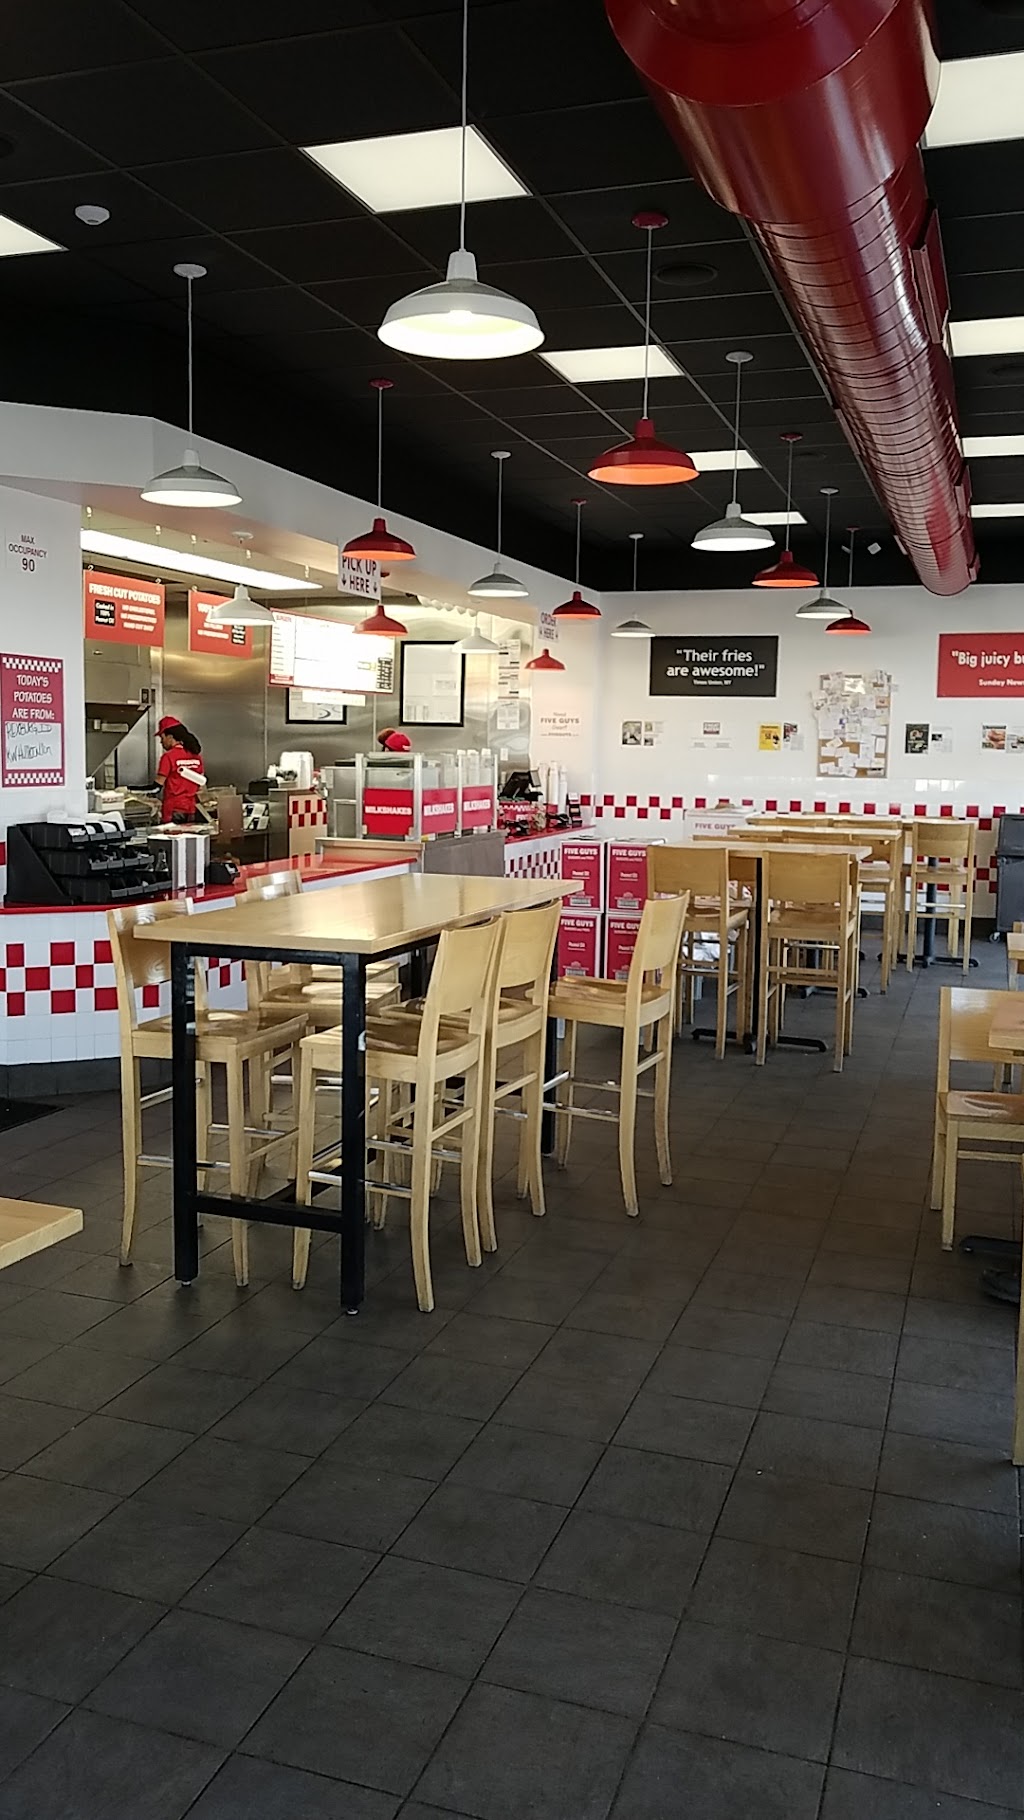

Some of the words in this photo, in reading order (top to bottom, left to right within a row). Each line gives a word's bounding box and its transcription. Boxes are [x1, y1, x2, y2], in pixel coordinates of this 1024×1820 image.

[21, 534, 35, 544] MAX
[8, 543, 47, 558] OCCUPANCY
[22, 558, 35, 572] 90
[342, 556, 362, 573] PICK
[366, 559, 377, 576] UP
[349, 574, 369, 594] HERE
[89, 583, 113, 597] FRESH
[113, 587, 128, 600] CUT
[128, 590, 161, 605] POTATOES
[676, 649, 719, 662] "Their
[722, 649, 753, 662] fries
[952, 650, 978, 669] "Big
[981, 651, 1011, 668] juicy
[666, 666, 689, 677] are
[692, 664, 765, 677] awesome!"
[17, 674, 49, 687] TODAY'S
[979, 678, 1006, 687] Sunday
[13, 691, 53, 704] POTATOES
[12, 708, 29, 719] ARE
[30, 708, 55, 720] FROM:
[694, 822, 711, 830] FIVE
[563, 847, 579, 856] FIVE
[579, 848, 598, 856] GUYS
[612, 848, 627, 857] FIVE
[627, 849, 647, 857] GUYS
[560, 918, 576, 926] FIVE
[576, 919, 594, 928] GUYS
[610, 921, 625, 929] FIVE
[626, 922, 640, 930] GUY
